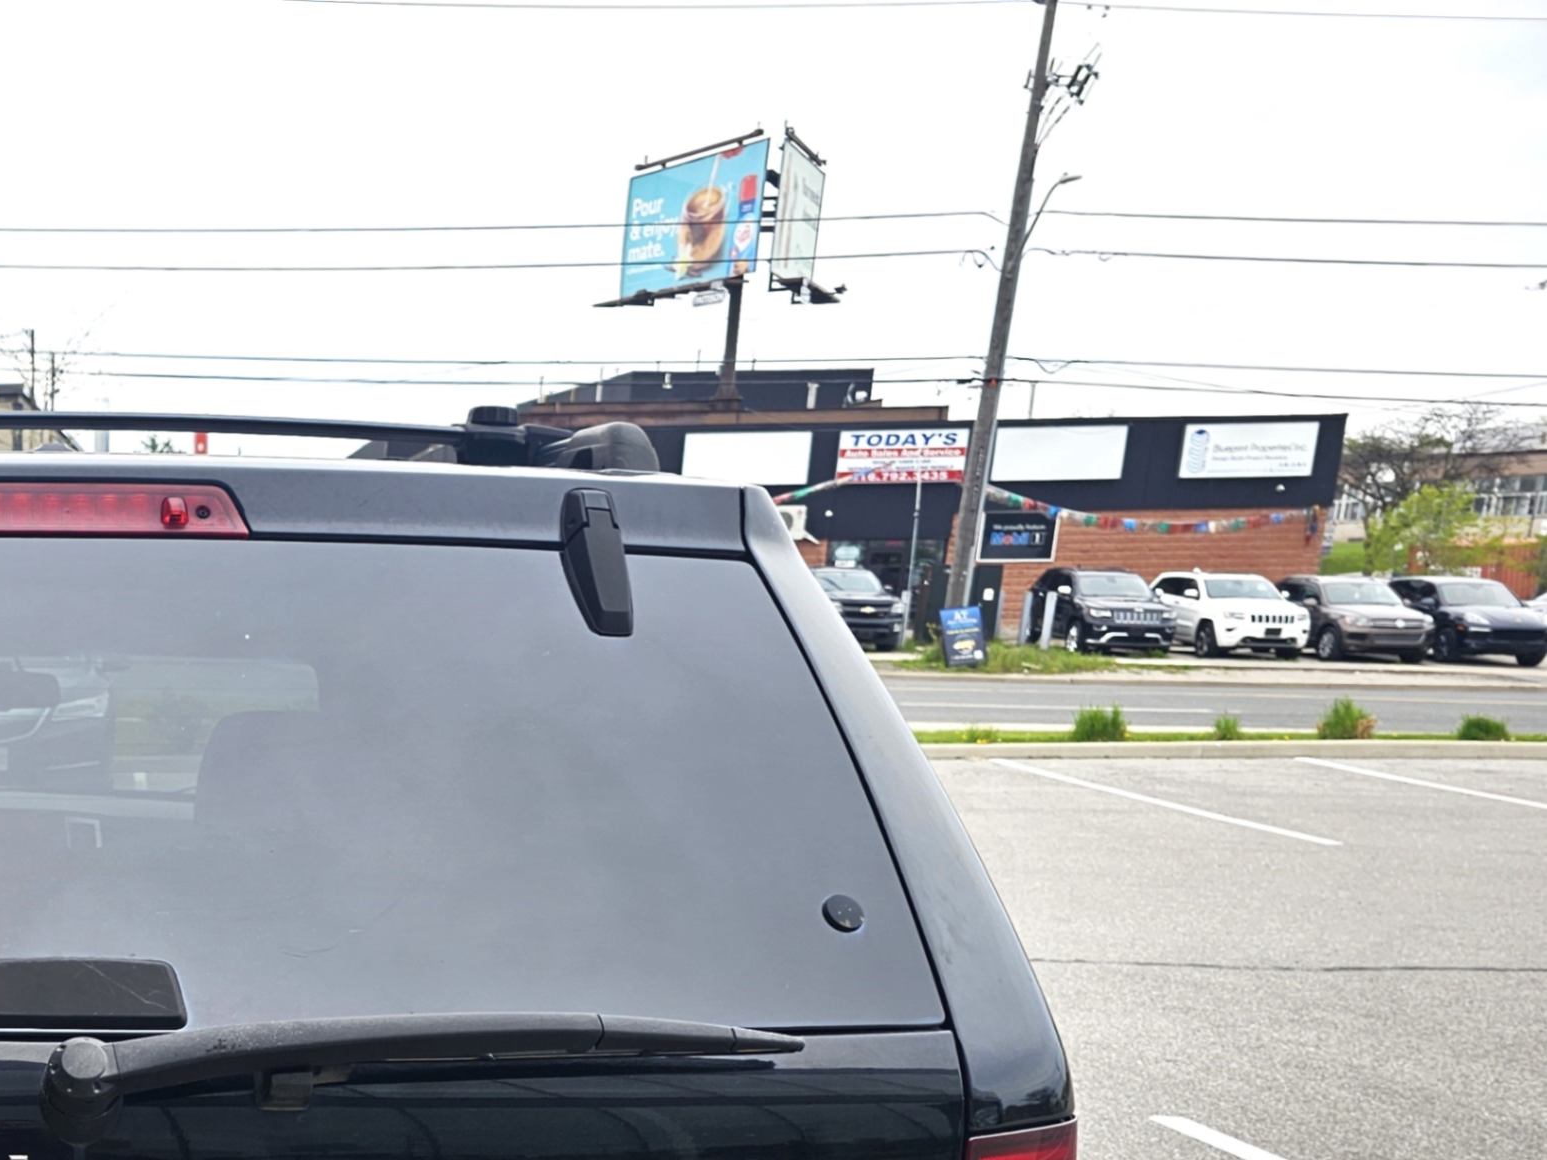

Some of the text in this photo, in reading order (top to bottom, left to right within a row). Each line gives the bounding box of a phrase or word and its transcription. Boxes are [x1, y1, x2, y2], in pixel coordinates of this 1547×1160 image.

[633, 198, 664, 218] Pour
[851, 432, 958, 447] TODAY'S
[844, 449, 870, 458] Auto
[871, 448, 900, 458] Sales
[922, 447, 962, 457] Service
[990, 531, 1030, 545] Mobil
